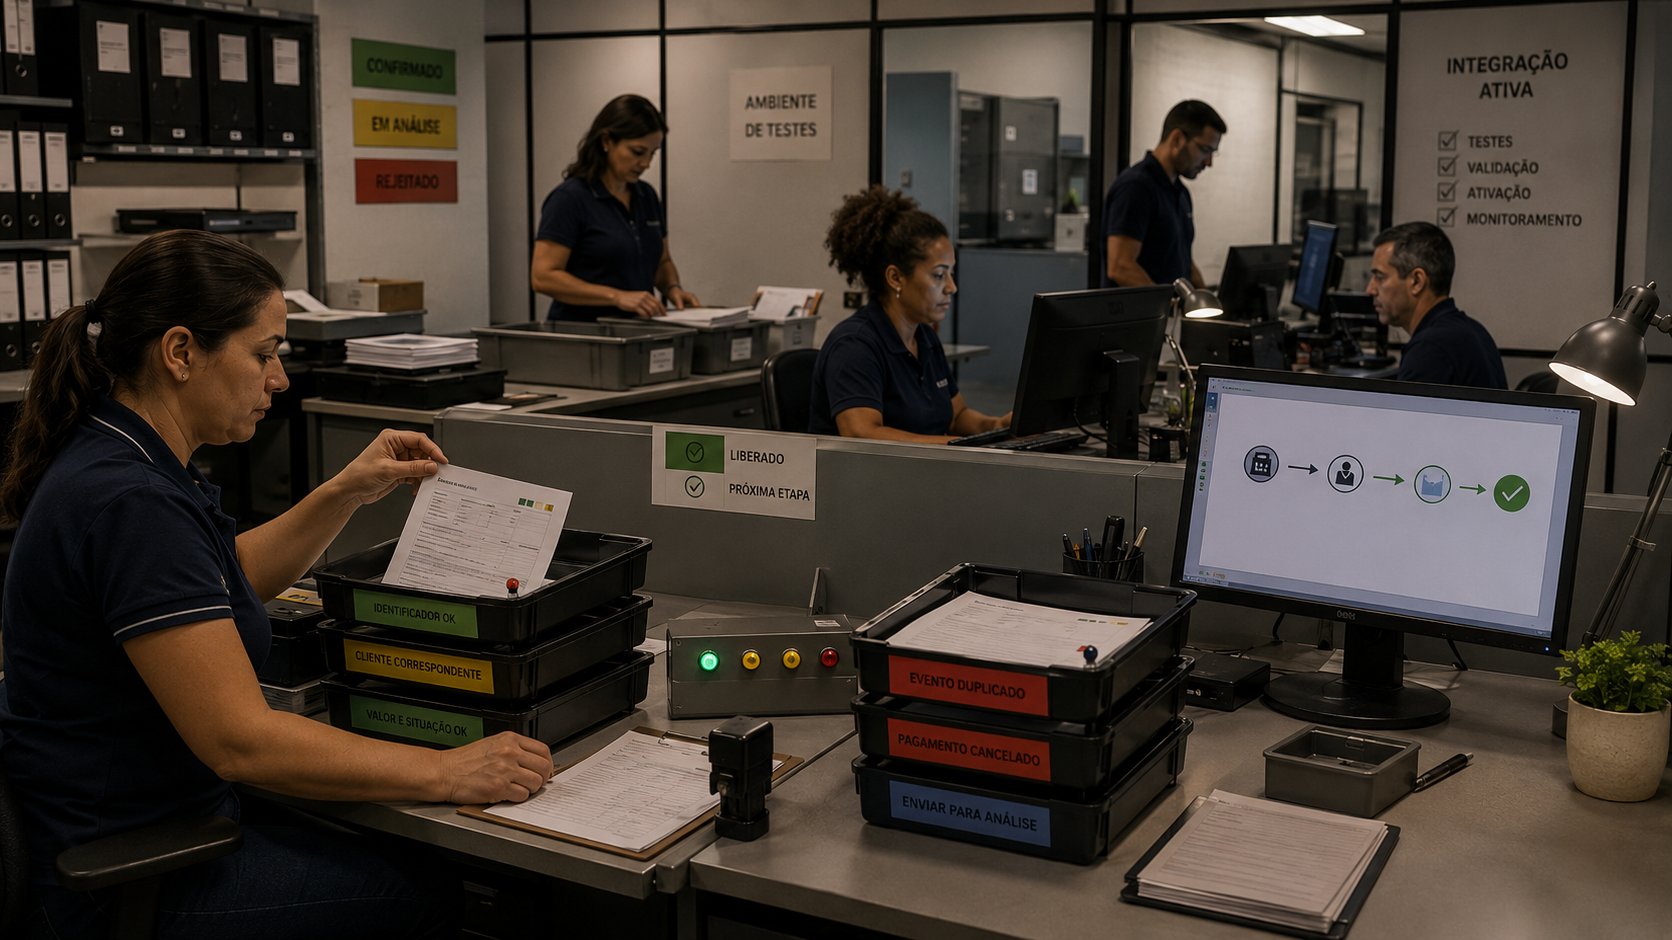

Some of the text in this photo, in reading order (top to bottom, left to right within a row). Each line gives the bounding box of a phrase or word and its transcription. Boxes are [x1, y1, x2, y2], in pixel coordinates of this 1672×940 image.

[367, 57, 443, 79] CONFIRMADO
[1447, 49, 1568, 75] INTEGRAÇÃO
[1479, 81, 1533, 98] ATIVA
[745, 94, 816, 109] AMBIENTE
[372, 115, 441, 134] EM ANÁLISE
[746, 122, 817, 137] DE TESTES
[1468, 135, 1513, 149] TESTES
[1468, 159, 1539, 177] VALIDAÇÃO
[376, 174, 439, 190] REJEITADO
[1468, 184, 1531, 202] ATIVAÇÃO
[1467, 213, 1582, 227] MONITORAMENTO
[731, 450, 784, 465] LIBERADO
[730, 481, 810, 502] PRÓXIMA ETAPA
[374, 603, 455, 625] IDENTIFICADOR OK
[355, 651, 482, 680] CLIENTE CORRESPONDENTE
[910, 672, 1025, 700] EVENTO DUPLICADO
[366, 709, 467, 737] VALOR E SITUAÇÃO OK
[898, 734, 1040, 767] PAGAMENTO CANCELADO
[903, 796, 1037, 831] ENVIAR PARA ANÁLISE
